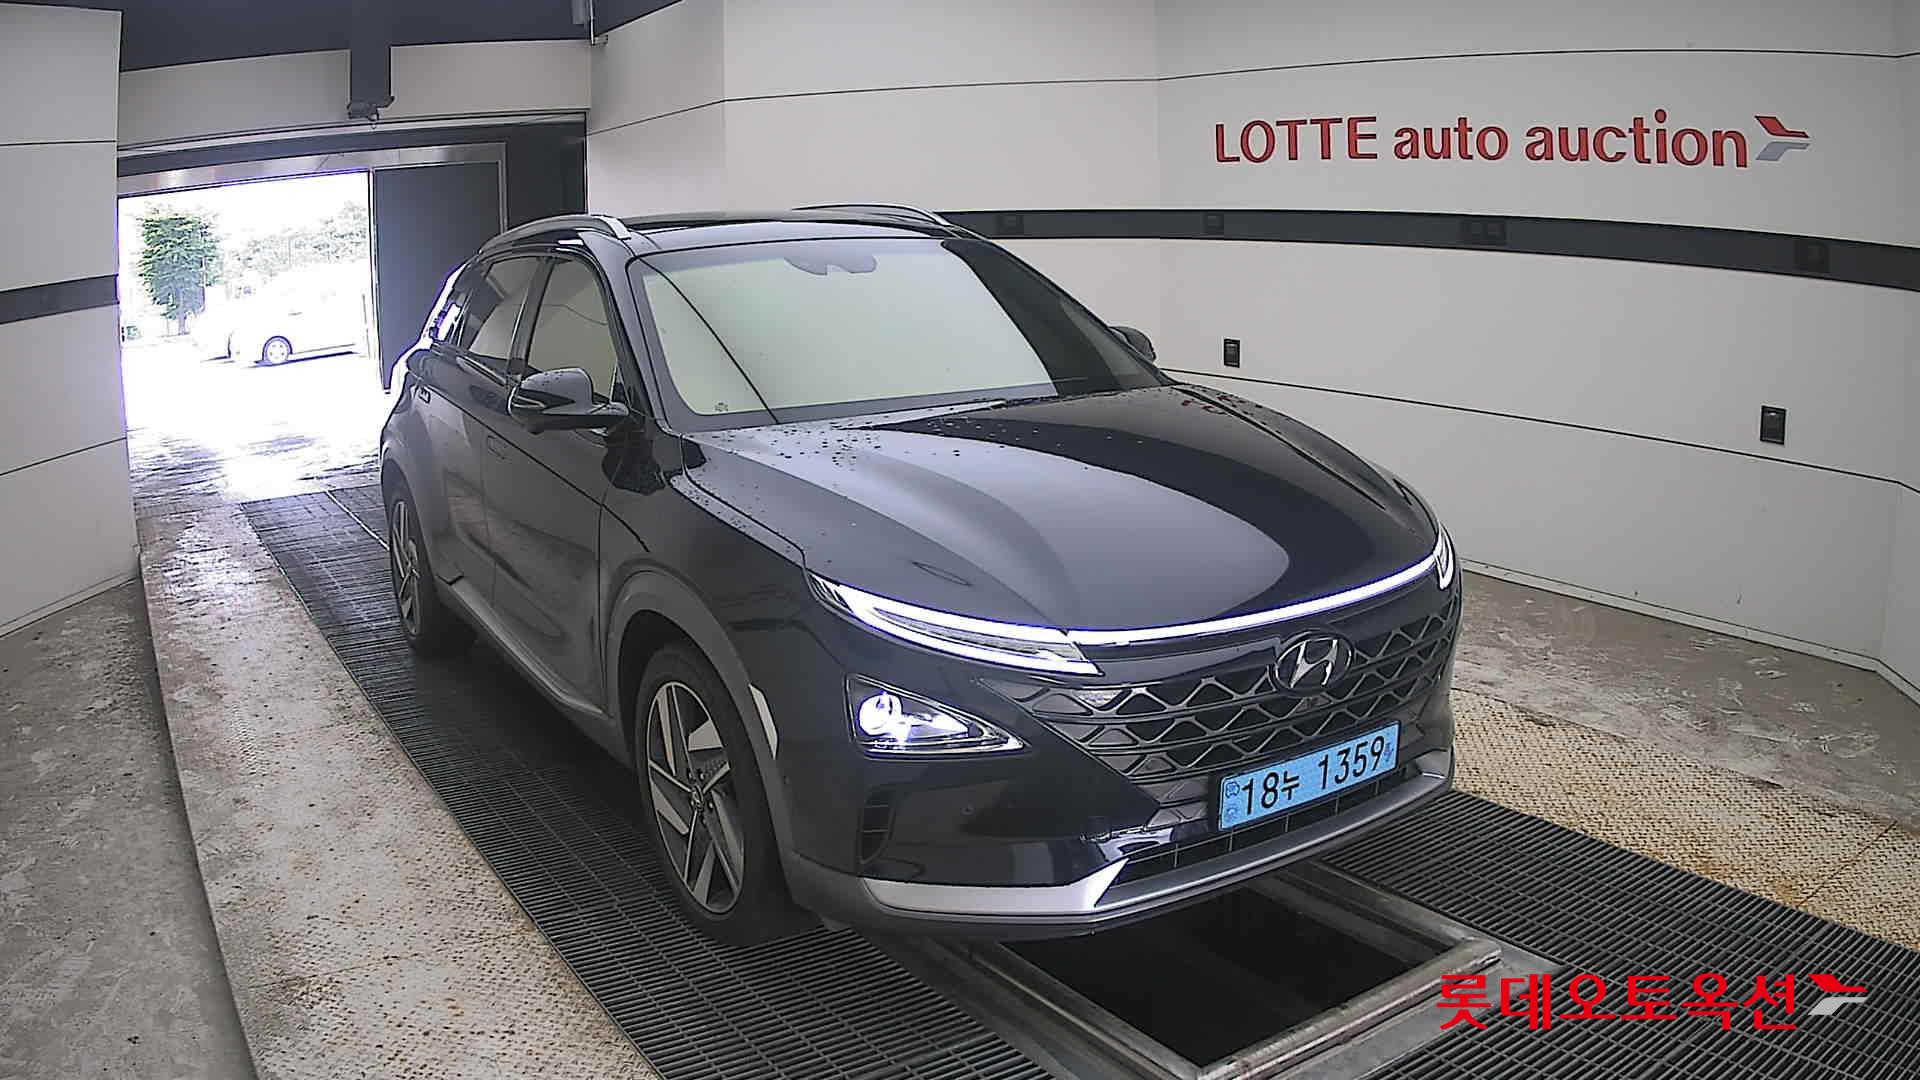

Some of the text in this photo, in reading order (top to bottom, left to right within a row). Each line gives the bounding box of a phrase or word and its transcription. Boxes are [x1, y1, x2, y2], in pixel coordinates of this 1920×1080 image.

[1215, 109, 1748, 168] LOTTE auto auction
[1242, 770, 1300, 814] 18누
[1318, 735, 1385, 789] 1359
